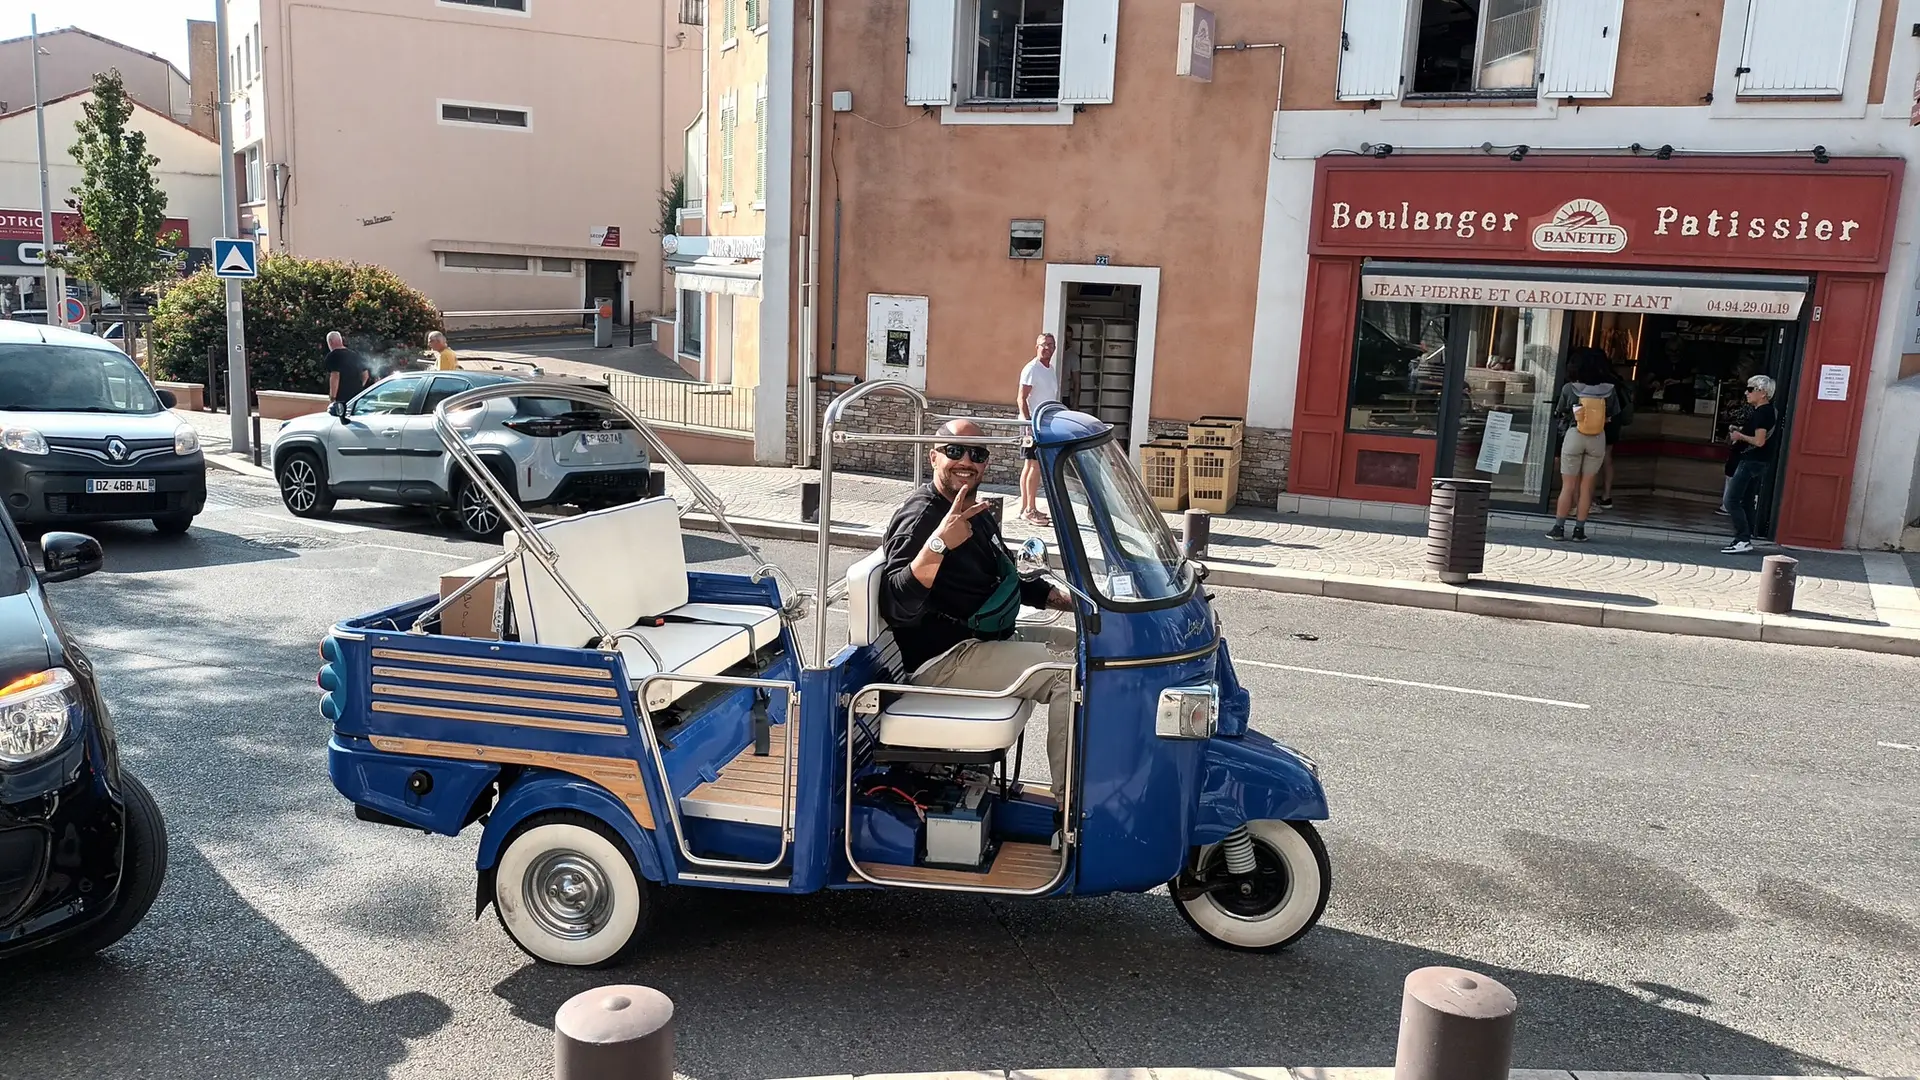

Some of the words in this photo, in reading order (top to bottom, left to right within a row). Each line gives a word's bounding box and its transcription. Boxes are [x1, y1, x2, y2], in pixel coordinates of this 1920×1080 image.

[1331, 201, 1519, 238] Boulanger
[1654, 206, 1859, 241] Patissier
[1542, 231, 1617, 245] BANETTE
[1096, 256, 1108, 264] 221
[1370, 283, 1482, 300] JEAN-PIERRE
[1488, 288, 1510, 301] ET
[1515, 289, 1606, 306] CAROLINE
[1612, 293, 1672, 310] FIANT
[1707, 299, 1790, 314] 04.94.29.01.19
[95, 480, 148, 491] DZ-488-AL
